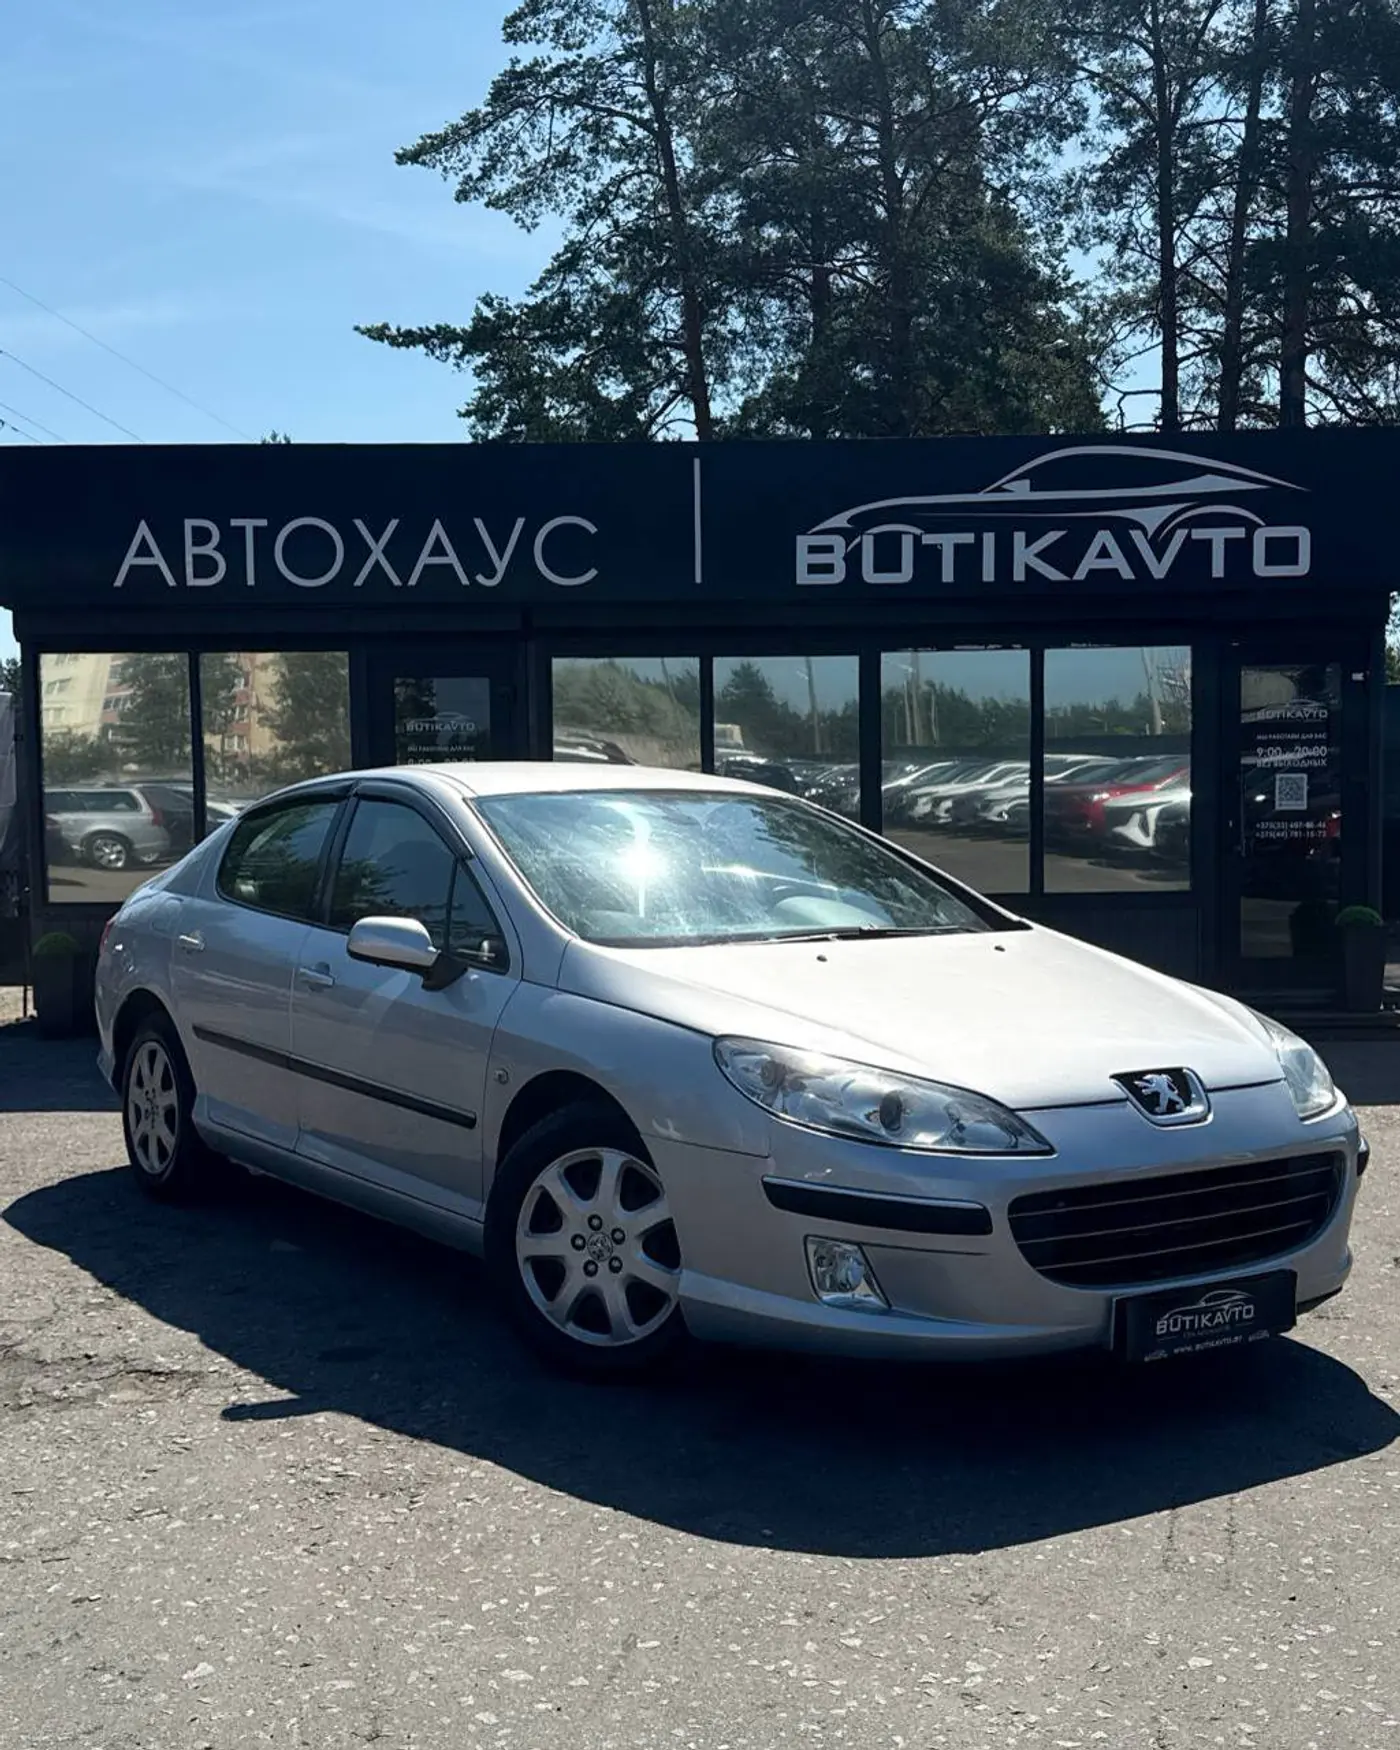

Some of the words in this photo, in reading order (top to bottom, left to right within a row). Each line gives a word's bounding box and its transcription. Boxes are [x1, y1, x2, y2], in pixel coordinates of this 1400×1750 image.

[113, 515, 600, 588] АВТОХАУС
[795, 525, 1311, 586] BUTIKAVTO
[1155, 1304, 1256, 1336] BUTIKAVTO
